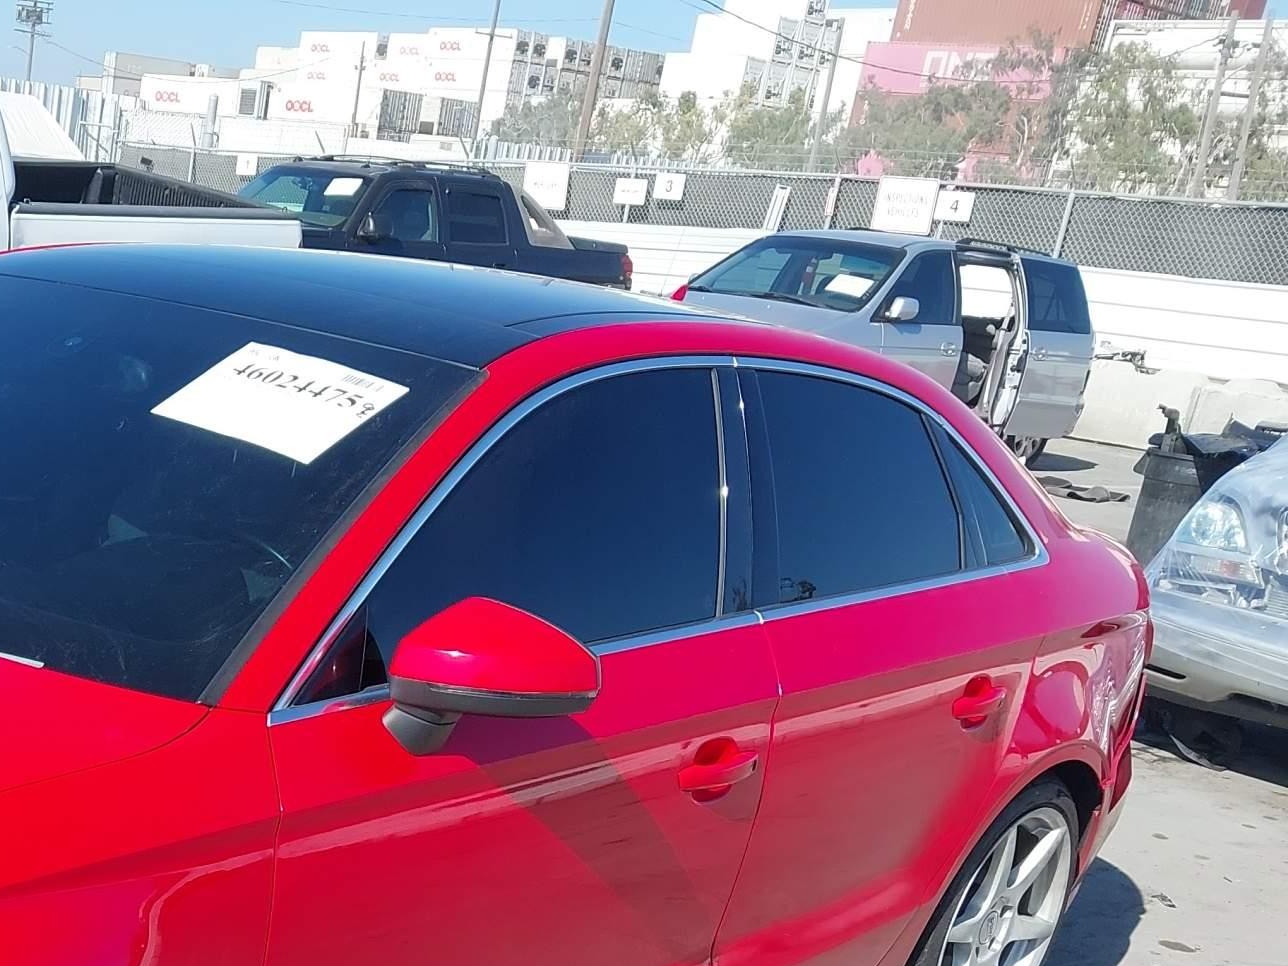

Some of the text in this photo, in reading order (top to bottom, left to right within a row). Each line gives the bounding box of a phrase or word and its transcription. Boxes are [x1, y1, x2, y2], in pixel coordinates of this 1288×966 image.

[155, 90, 181, 103] OOCL
[285, 99, 314, 113] OOCL
[665, 179, 673, 193] 3
[950, 199, 960, 213] 4
[233, 363, 364, 408] 46024475
